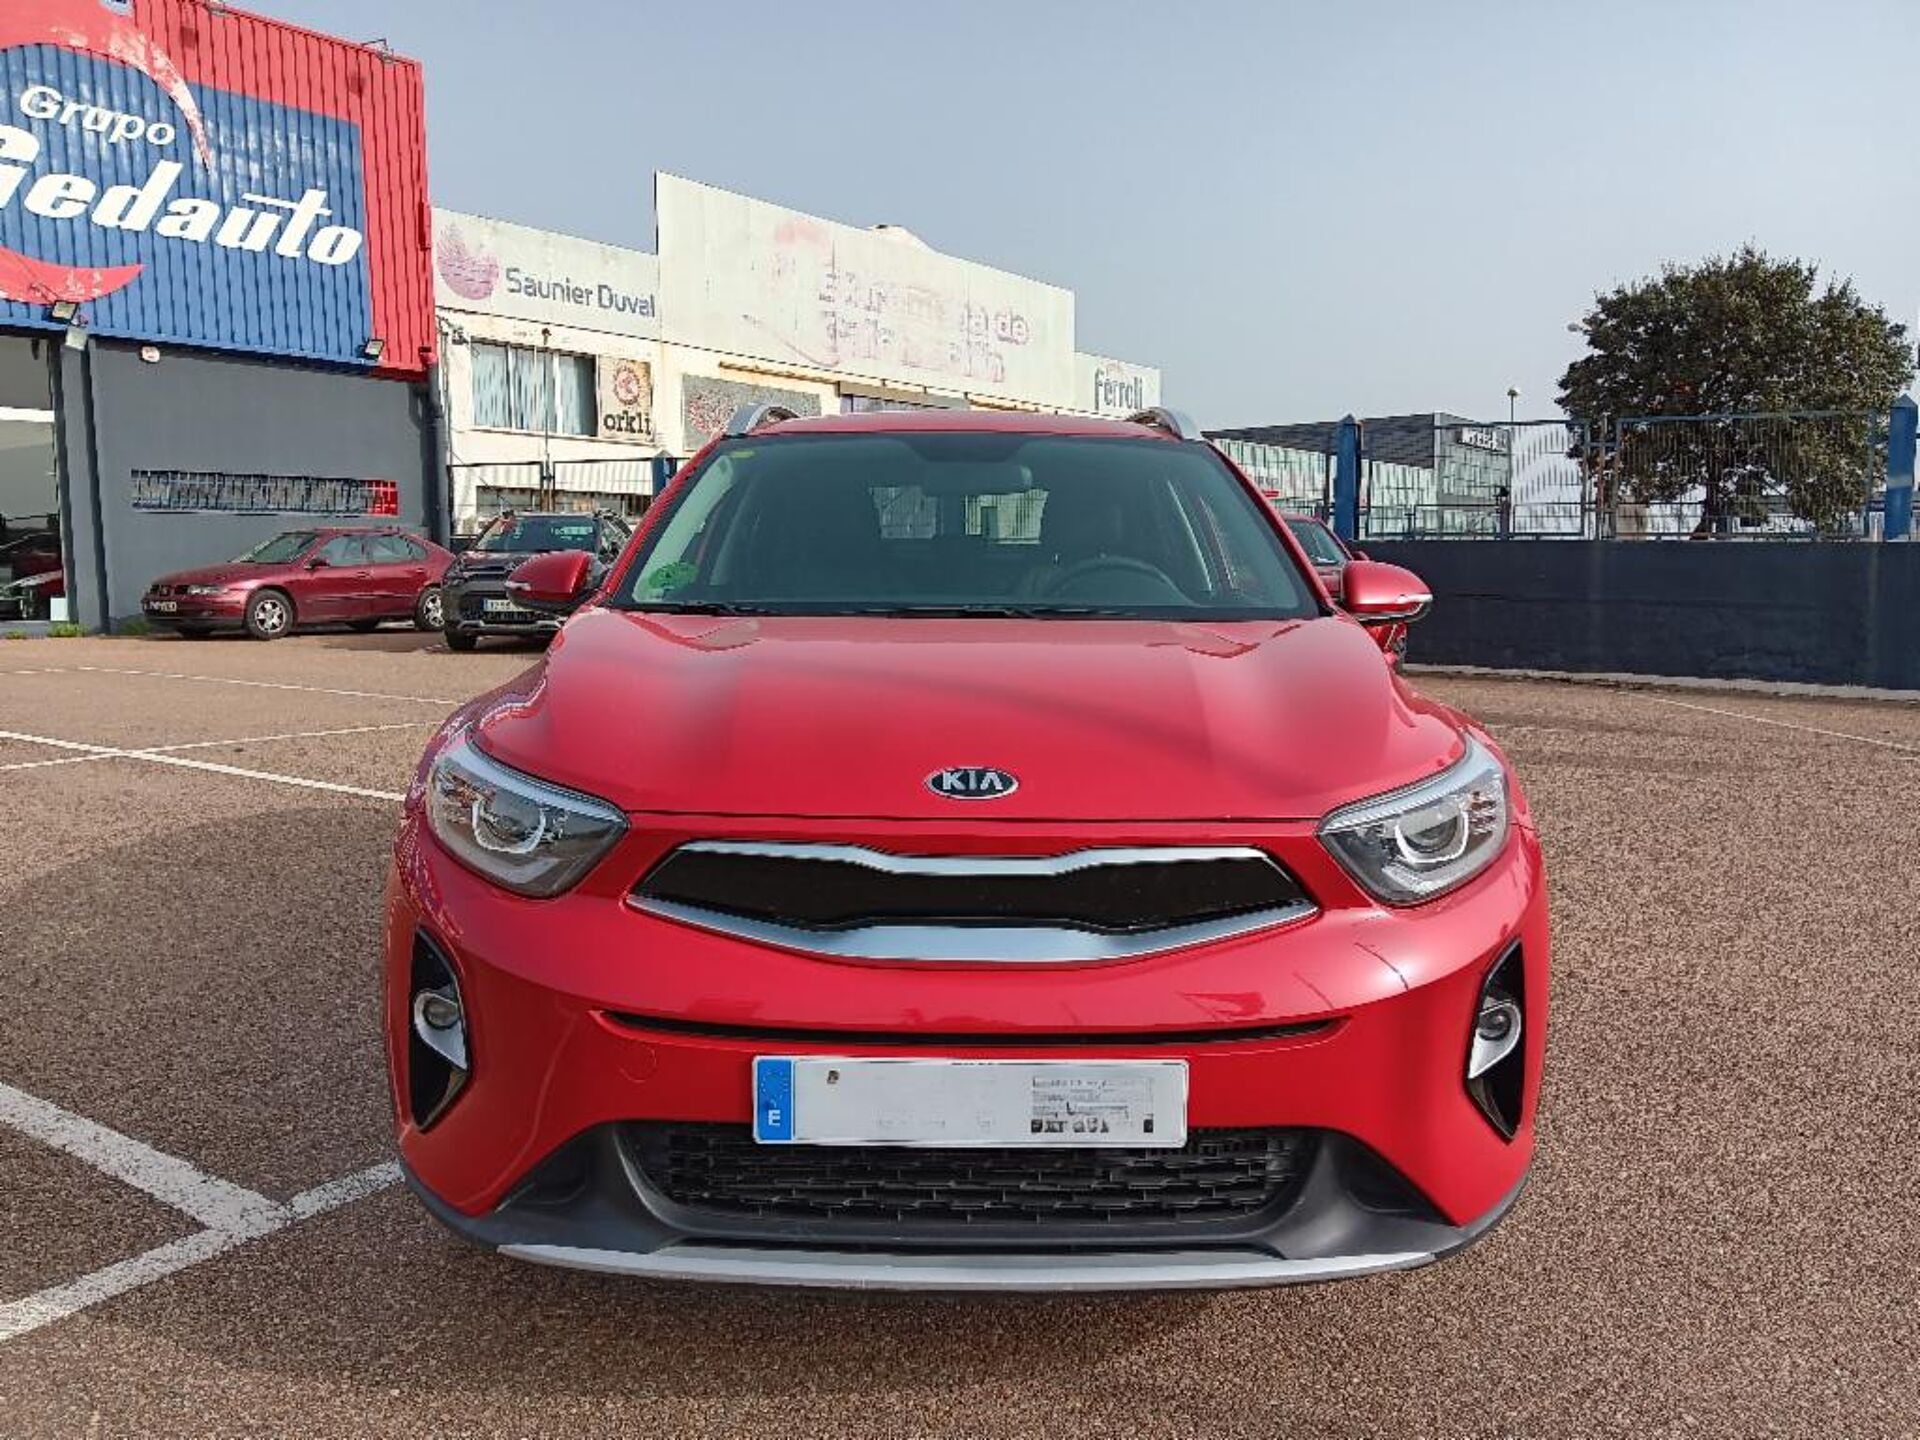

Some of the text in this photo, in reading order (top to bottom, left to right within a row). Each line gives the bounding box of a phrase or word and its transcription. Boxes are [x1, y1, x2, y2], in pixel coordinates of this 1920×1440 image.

[20, 85, 175, 145] Grupo
[506, 267, 655, 317] Saunier Duval
[603, 409, 651, 435] orkli
[942, 770, 1003, 790] KIA
[768, 1109, 781, 1126] E
